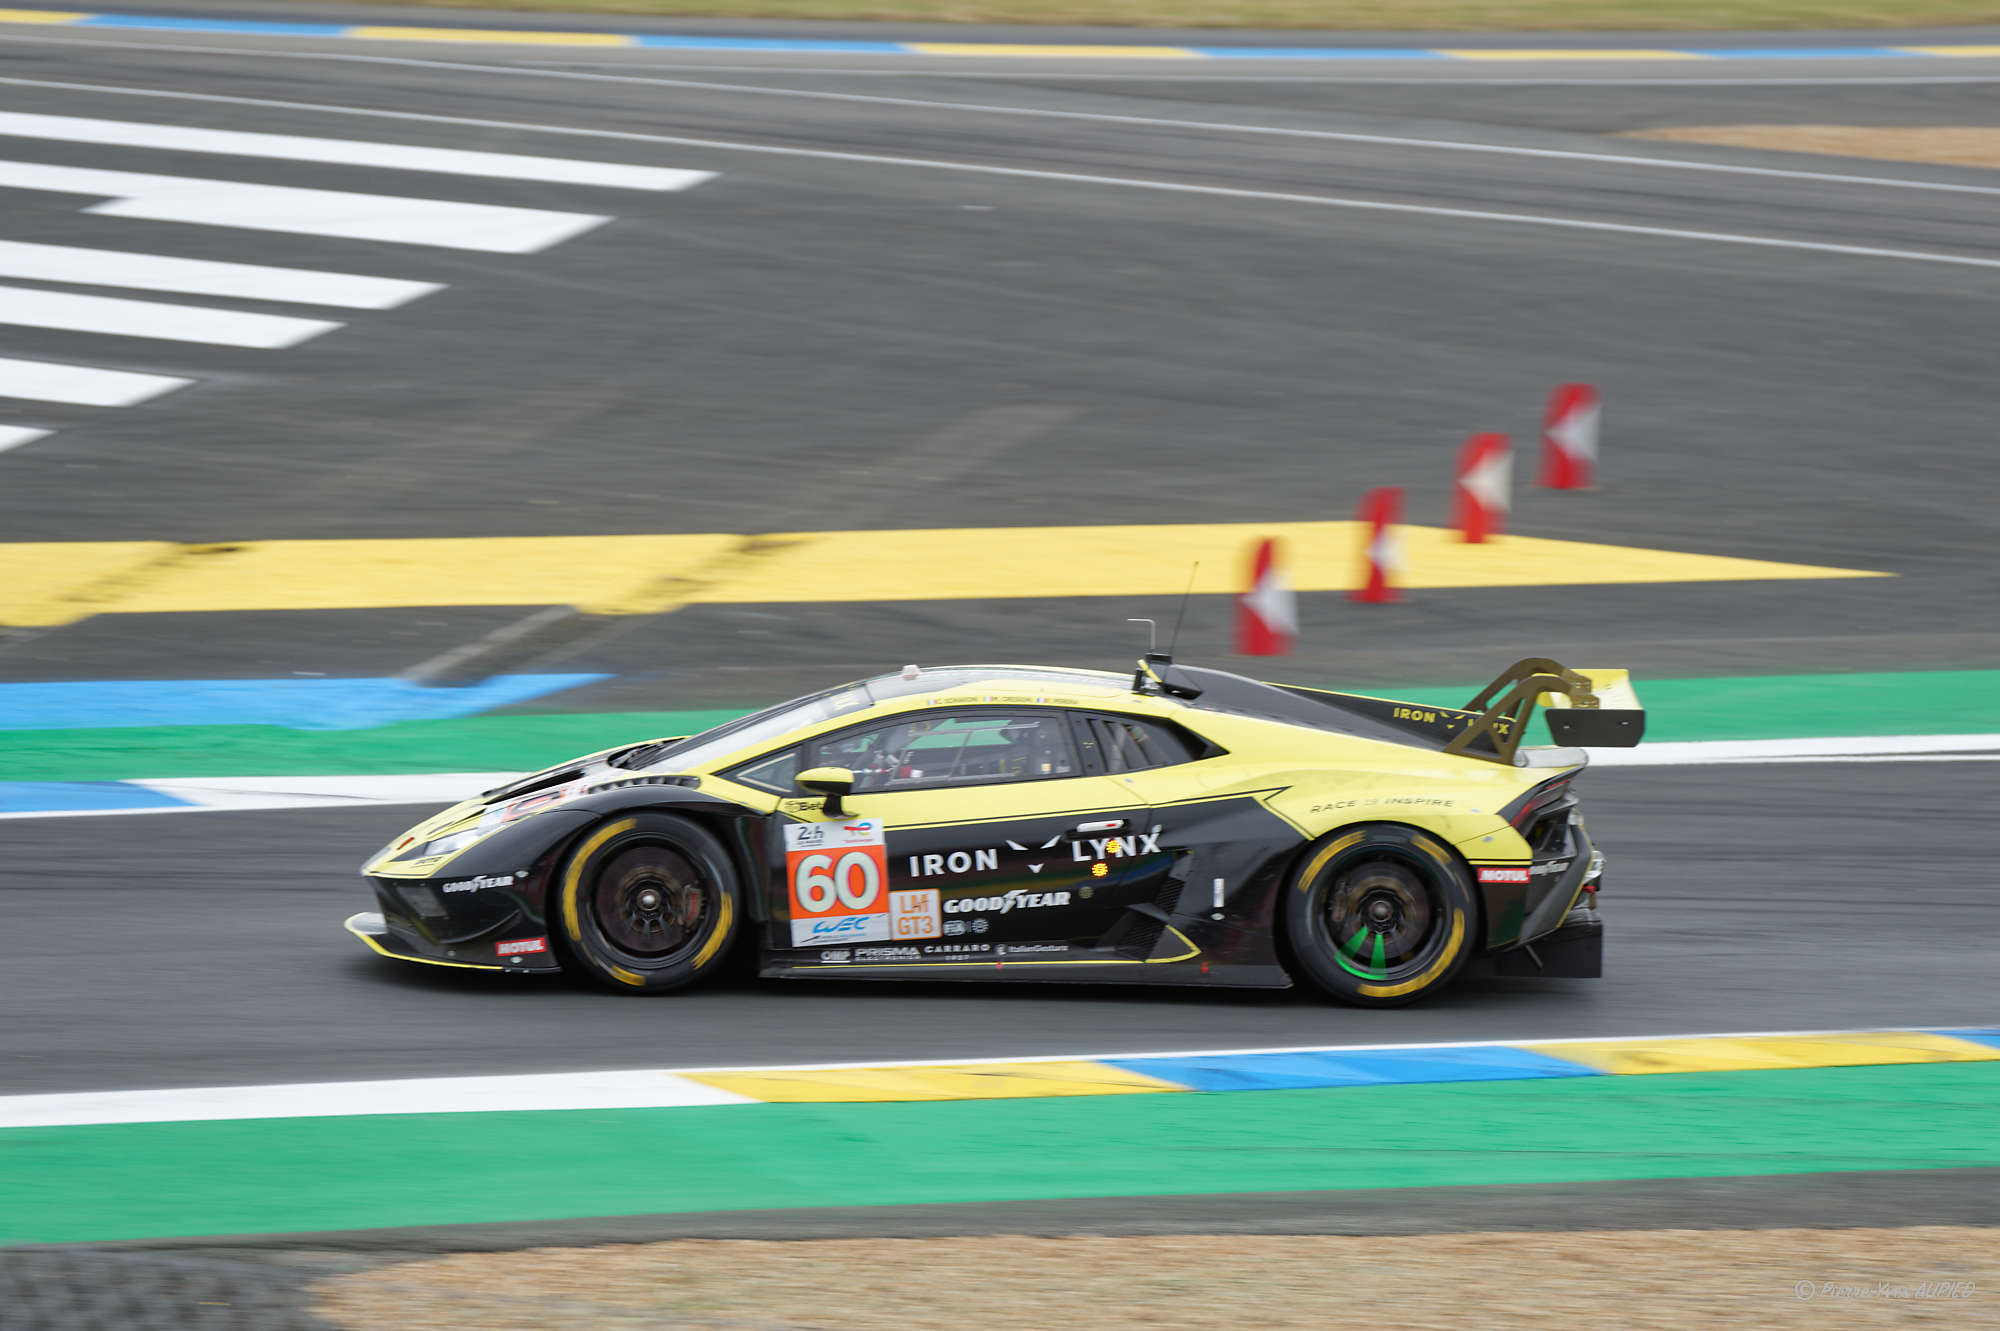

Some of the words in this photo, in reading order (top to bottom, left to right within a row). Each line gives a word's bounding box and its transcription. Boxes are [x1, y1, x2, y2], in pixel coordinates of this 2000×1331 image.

[1393, 707, 1437, 724] IRON
[1309, 798, 1356, 814] RACE
[1384, 797, 1456, 808] INSPIRE
[909, 848, 998, 877] IRON
[1071, 832, 1162, 862] LYNX
[796, 851, 881, 913] 60
[1480, 869, 1529, 882] MOTUL
[900, 894, 929, 915] LM
[943, 889, 1072, 915] GOODYEAR
[812, 916, 871, 934] WEC
[897, 916, 934, 935] GT3
[497, 940, 545, 954] MOTUL
[854, 947, 921, 957] PRISMA
[923, 944, 991, 953] CARRARO
